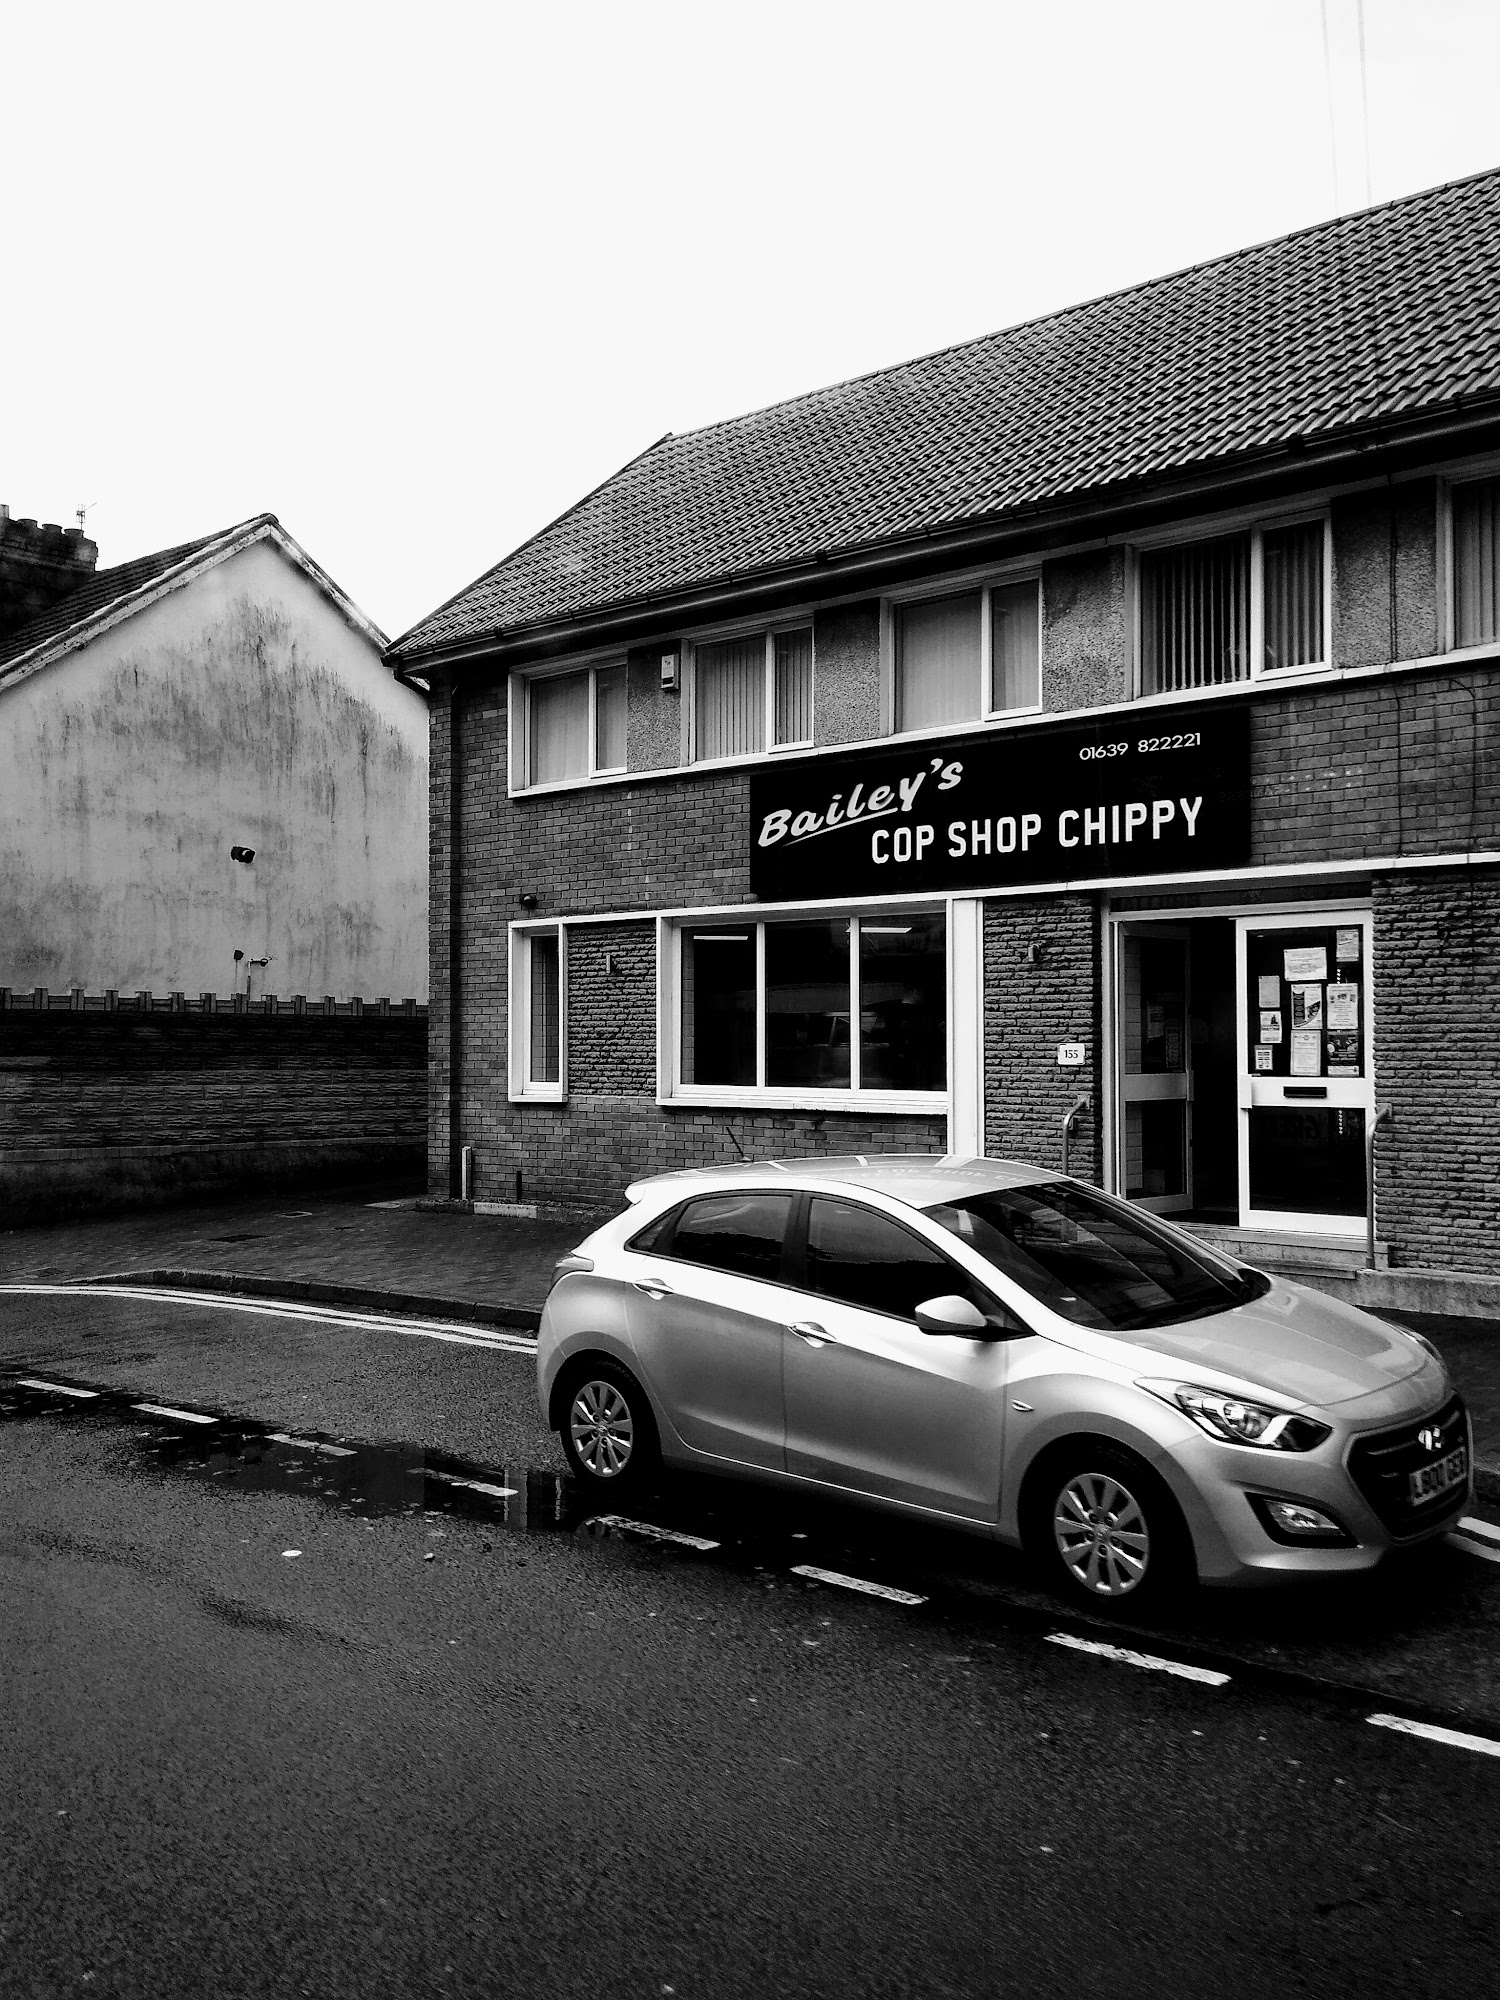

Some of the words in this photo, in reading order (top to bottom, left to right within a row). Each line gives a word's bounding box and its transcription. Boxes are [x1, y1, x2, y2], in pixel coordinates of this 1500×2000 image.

[1079, 742, 1129, 761] 01639
[1137, 732, 1201, 753] 822221
[757, 757, 964, 848] Bailey's
[871, 824, 935, 864] COP
[947, 813, 1042, 858] SHOP
[1058, 796, 1203, 848] CHIPPY
[1064, 1049, 1079, 1059] 155
